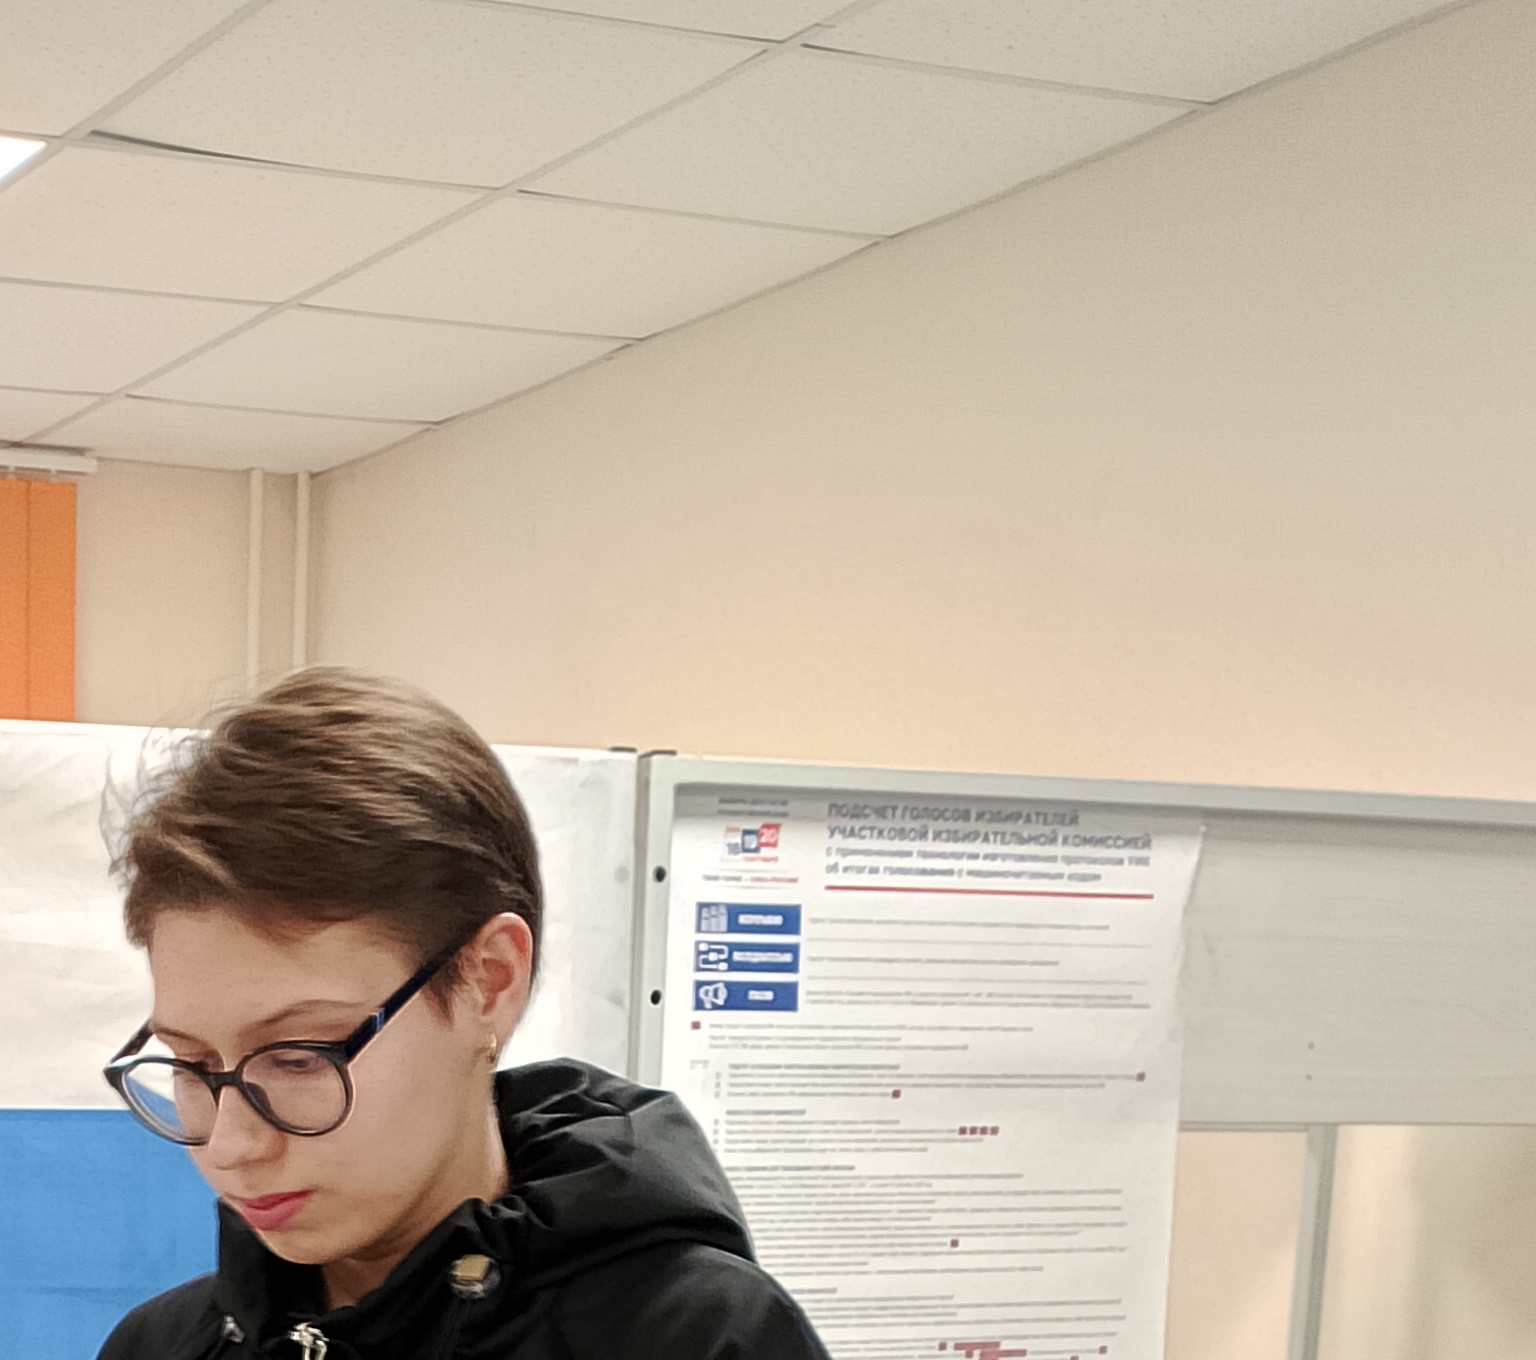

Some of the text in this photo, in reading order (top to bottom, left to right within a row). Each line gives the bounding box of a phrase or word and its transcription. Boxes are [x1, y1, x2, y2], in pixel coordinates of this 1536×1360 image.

[827, 803, 1079, 827] ПОДСЧЕТ ГОЛОСОВ ИЗБИРАТЕЛЕЙ
[827, 824, 1153, 850] УЧАСТКОВОЙ ИЗБИРАТЕЛЬНОЙ КОМИССИЕЙ
